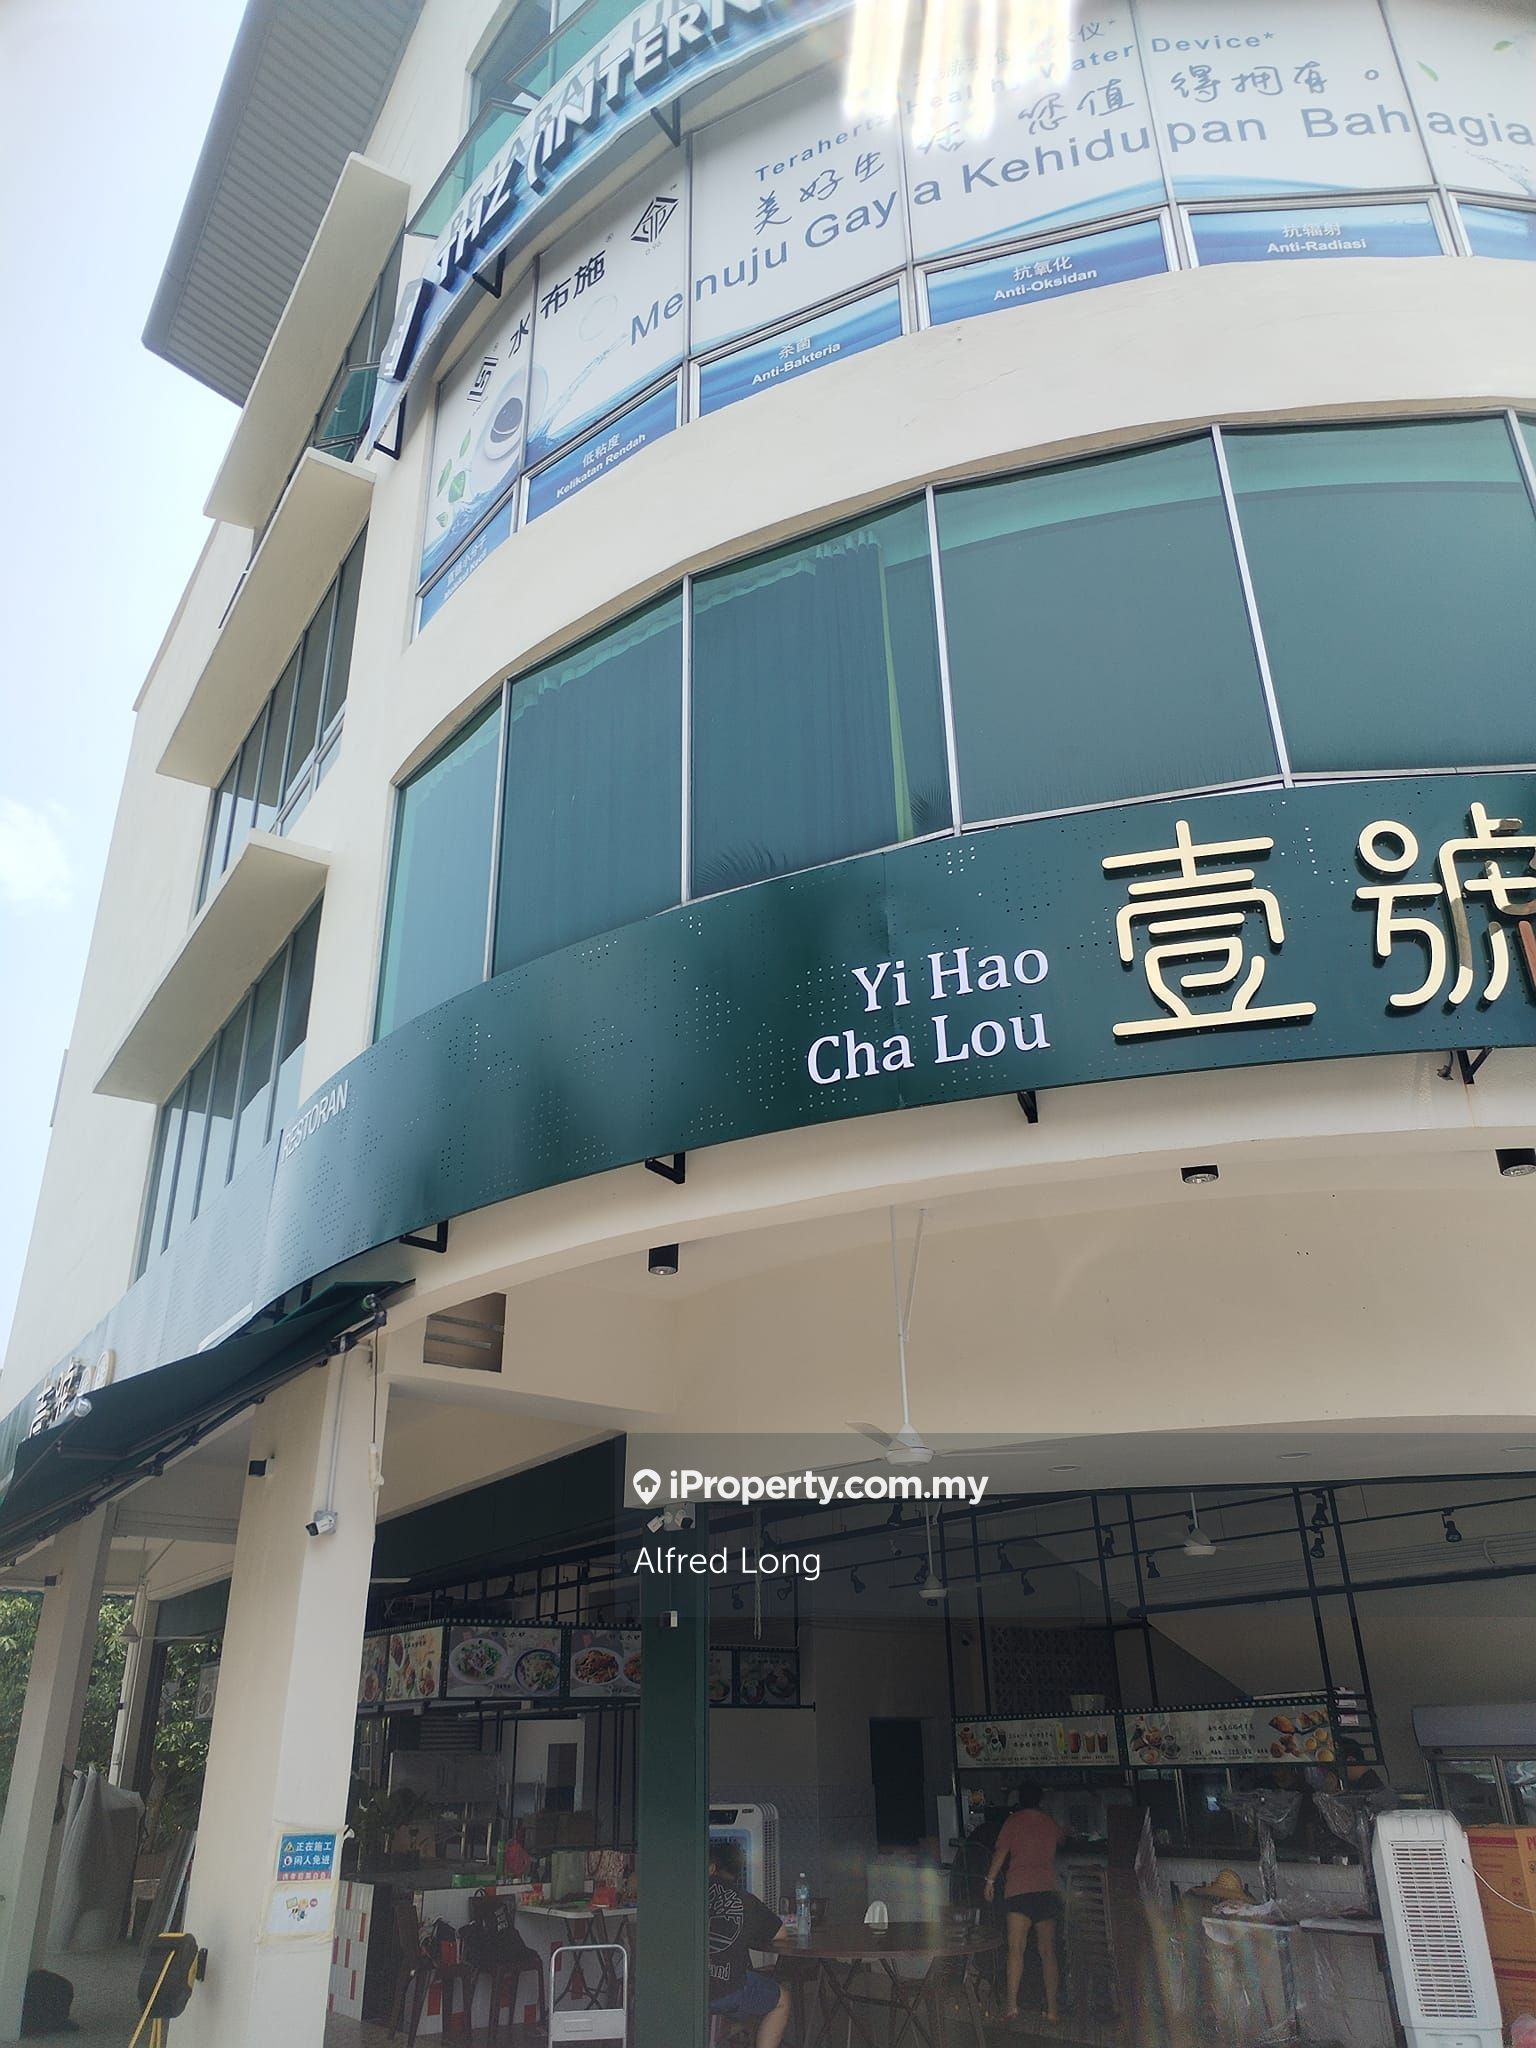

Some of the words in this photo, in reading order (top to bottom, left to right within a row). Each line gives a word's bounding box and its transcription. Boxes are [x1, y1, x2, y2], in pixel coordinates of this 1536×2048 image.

[1013, 256, 1073, 282] 抗氧化
[1267, 238, 1367, 253] Anti-Radiasi
[993, 269, 1098, 301] Anti-Oksidan
[752, 343, 841, 385] Anti-Bakteria
[556, 462, 603, 498] Kelikatan
[605, 434, 646, 466] Rendah
[851, 959, 911, 1014] Yi
[927, 946, 1049, 1001] Hao
[806, 1029, 915, 1086] Cha
[933, 1009, 1051, 1065] Lou
[280, 1080, 348, 1163] RESTORAN
